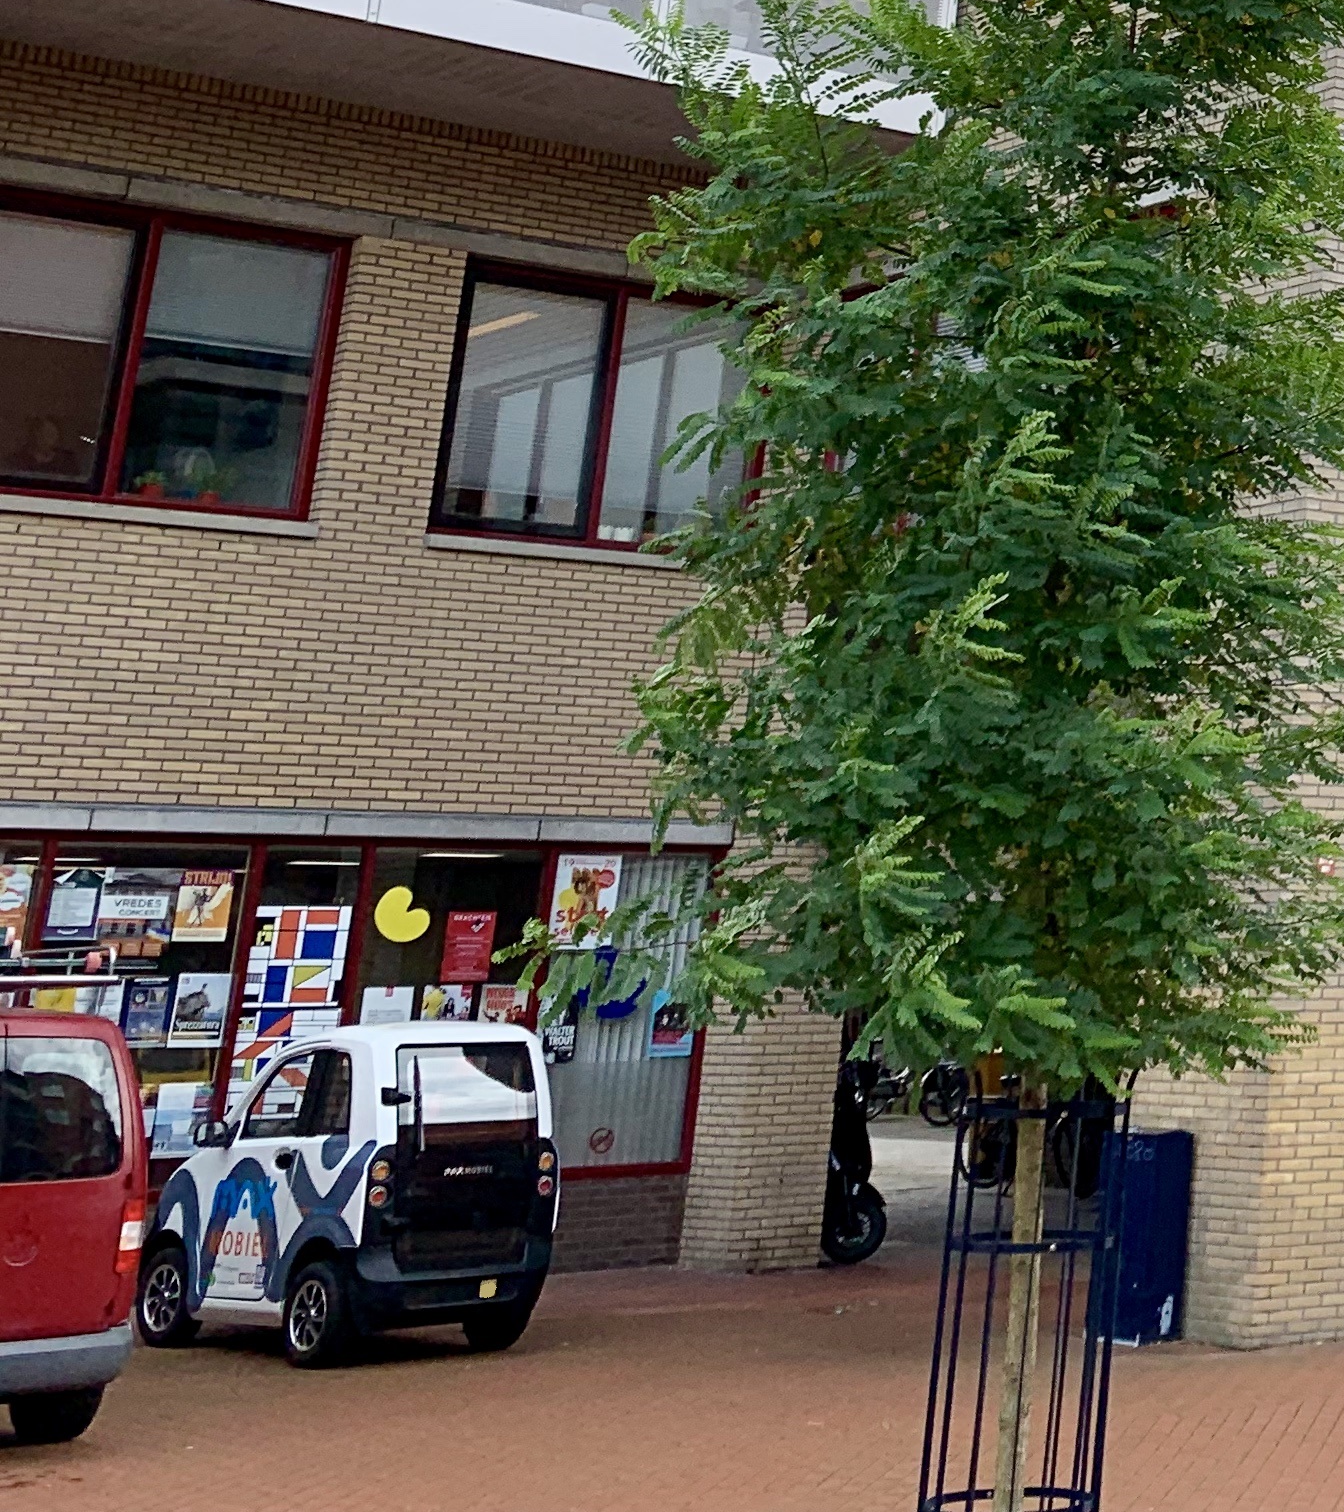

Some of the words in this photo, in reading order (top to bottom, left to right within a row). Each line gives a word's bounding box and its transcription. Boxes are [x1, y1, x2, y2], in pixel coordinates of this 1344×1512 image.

[114, 898, 162, 907] VREDES
[544, 1025, 576, 1037] WALTER
[548, 1035, 575, 1046] TROUT
